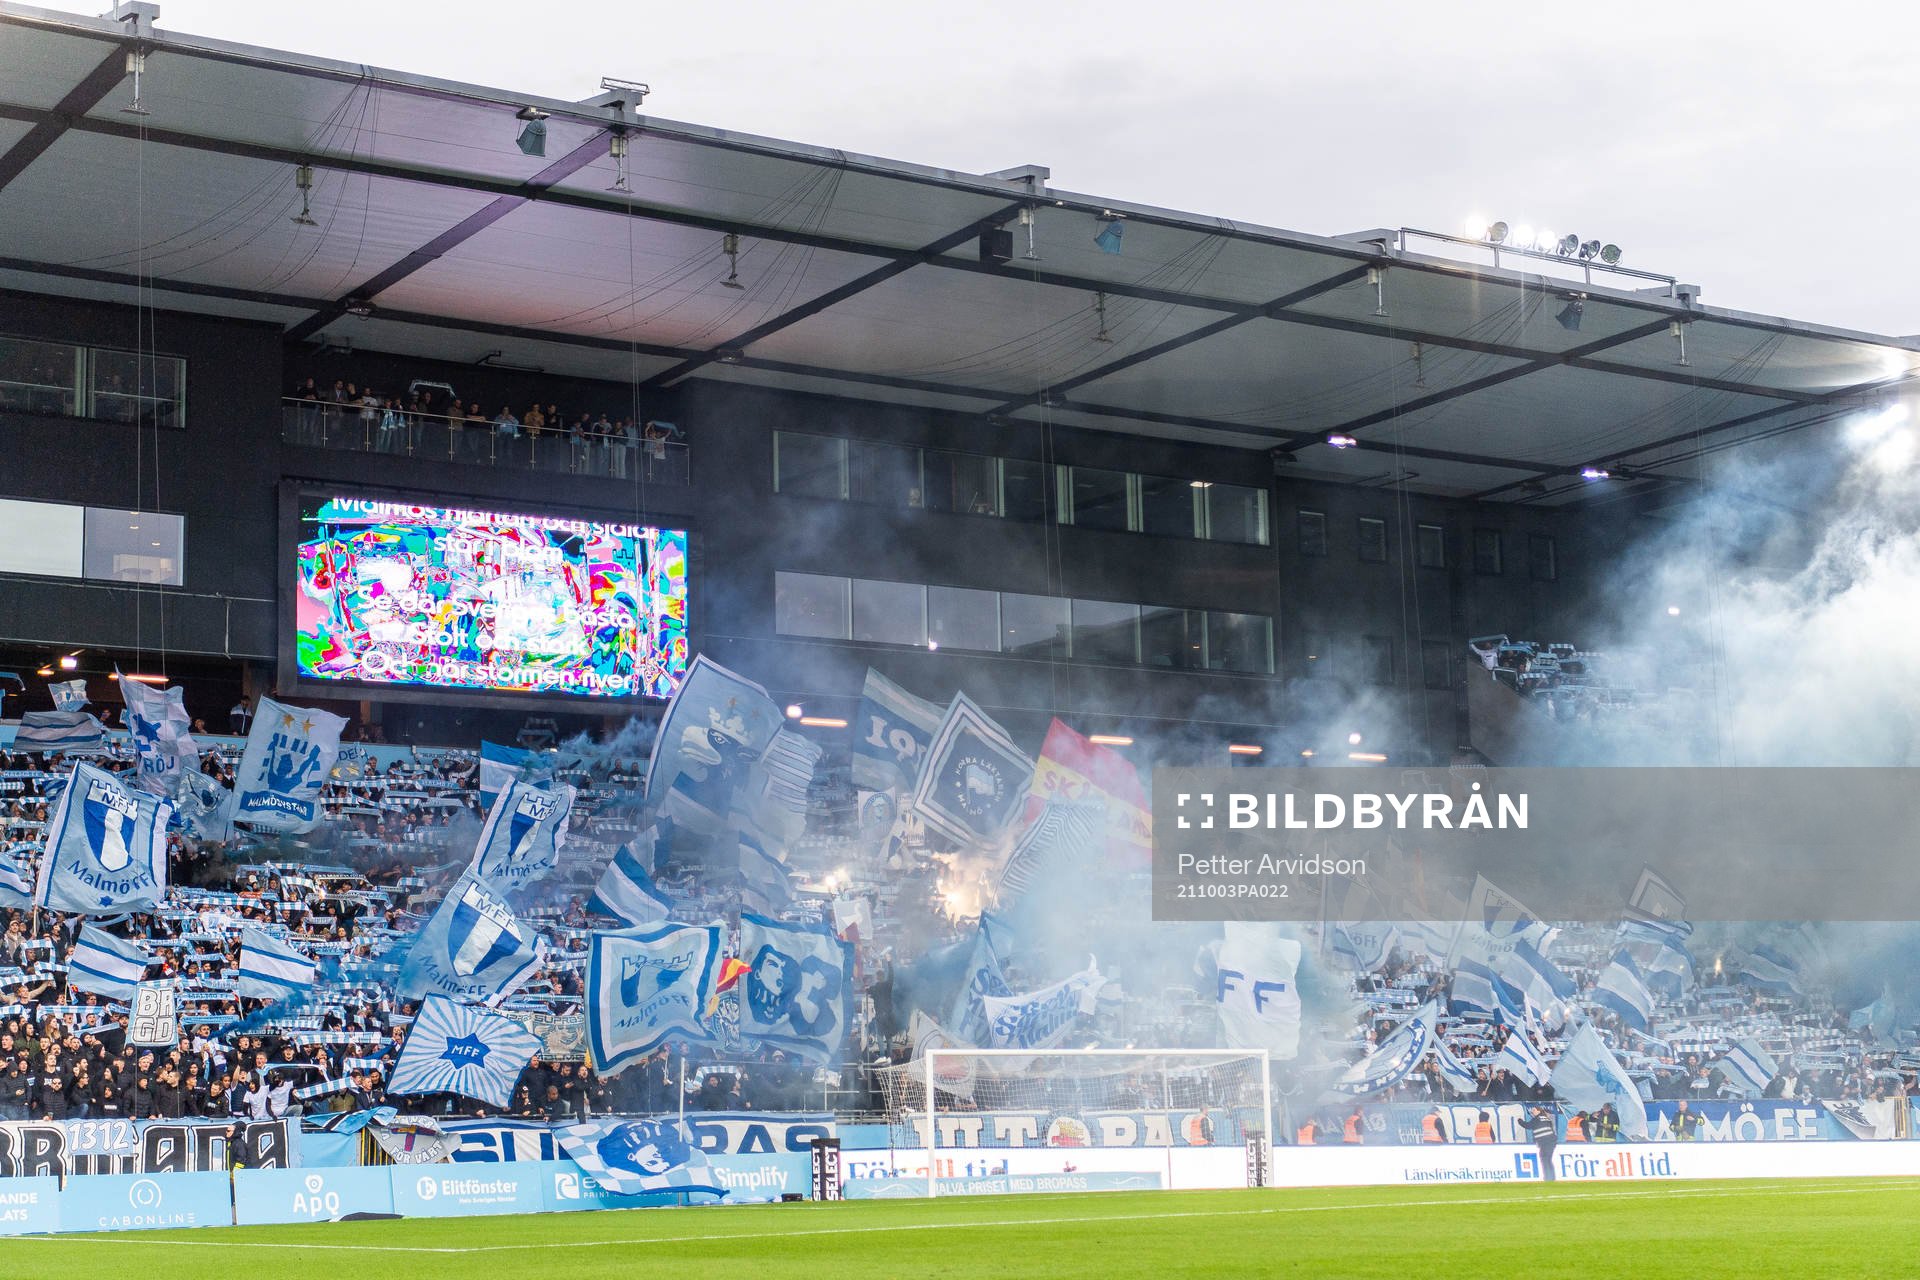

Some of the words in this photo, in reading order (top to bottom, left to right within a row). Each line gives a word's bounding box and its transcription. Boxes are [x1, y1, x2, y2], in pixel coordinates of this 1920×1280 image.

[356, 587, 393, 611] Se
[564, 599, 635, 629] bästa
[410, 621, 469, 648] Stolt
[361, 650, 418, 675] Och
[475, 661, 576, 687] stormen
[144, 754, 175, 775] RÖJ
[67, 859, 129, 895] Malmö
[137, 988, 174, 1017] BA
[132, 1016, 174, 1043] GD
[451, 1045, 480, 1058] MFF
[68, 1120, 130, 1151] 1312
[415, 1140, 443, 1164] VÅRT
[1560, 1154, 1599, 1178] För
[1605, 1152, 1632, 1177] all
[1639, 1152, 1677, 1177] tid.
[715, 1164, 788, 1191] Simplify
[813, 1148, 822, 1201] SELECT
[825, 1147, 839, 1201] SELECT
[968, 1180, 1007, 1194] PRISET
[1010, 1179, 1034, 1192] MED
[1037, 1176, 1088, 1190] BROPASS
[1404, 1165, 1513, 1182] Länsförsäkringar
[442, 1180, 518, 1196] Elitfönster
[292, 1192, 340, 1217] ApQ
[98, 1212, 197, 1227] CABONLINE
